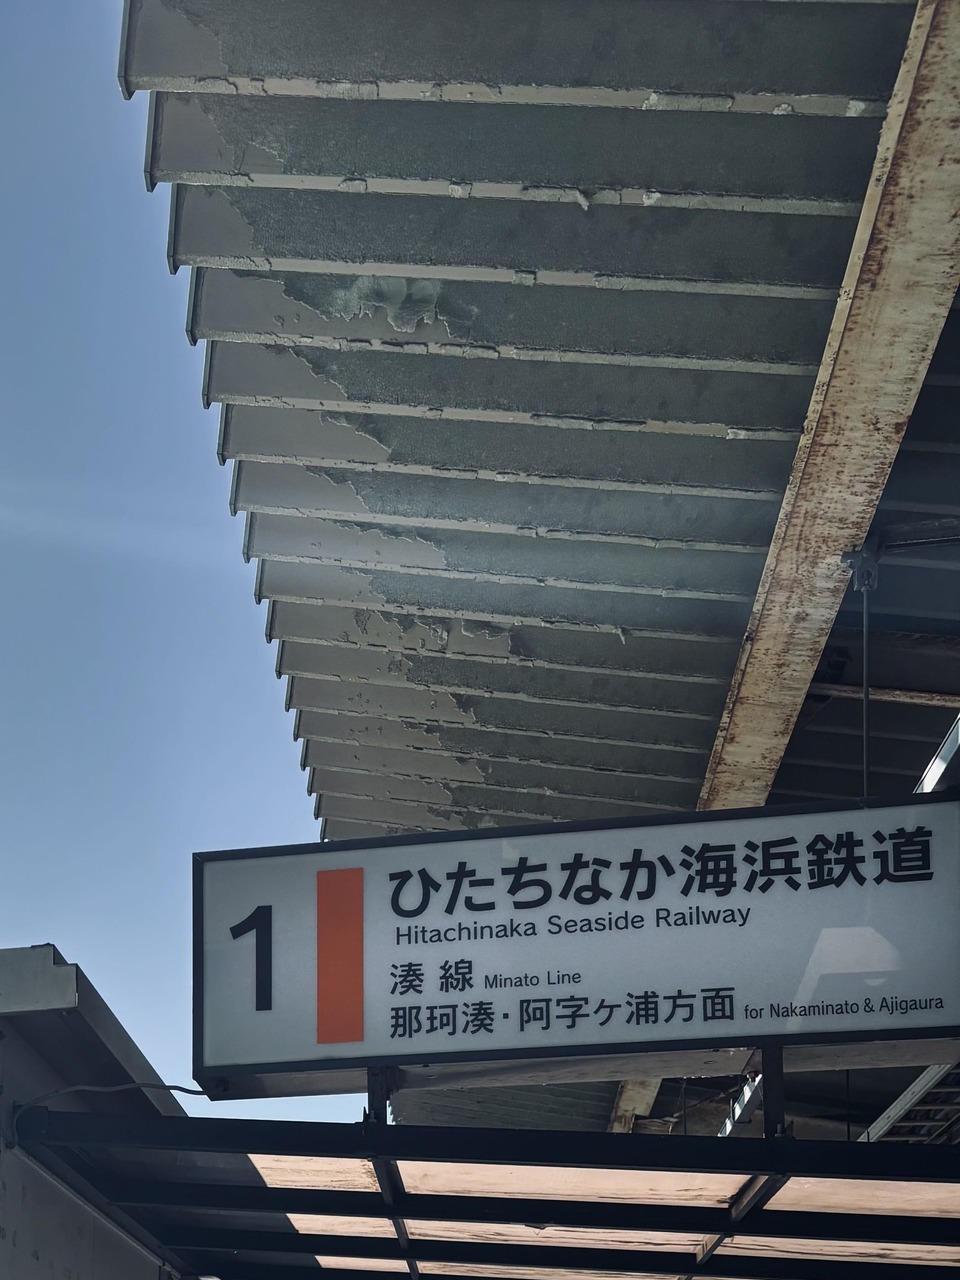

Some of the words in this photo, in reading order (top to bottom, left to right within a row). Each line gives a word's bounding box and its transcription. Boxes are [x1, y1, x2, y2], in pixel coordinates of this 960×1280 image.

[389, 826, 934, 919] ひたちなか海浜鉄道
[396, 917, 537, 946] Hitachinaka
[547, 910, 645, 935] Seaside
[655, 904, 751, 933] Railway
[229, 904, 274, 1011] 1
[484, 972, 540, 988] Minato
[547, 969, 582, 985] Line
[744, 1003, 763, 1020] for
[769, 999, 860, 1020] Nakaminato
[863, 998, 875, 1014] &
[878, 995, 944, 1017] Ajigaura
